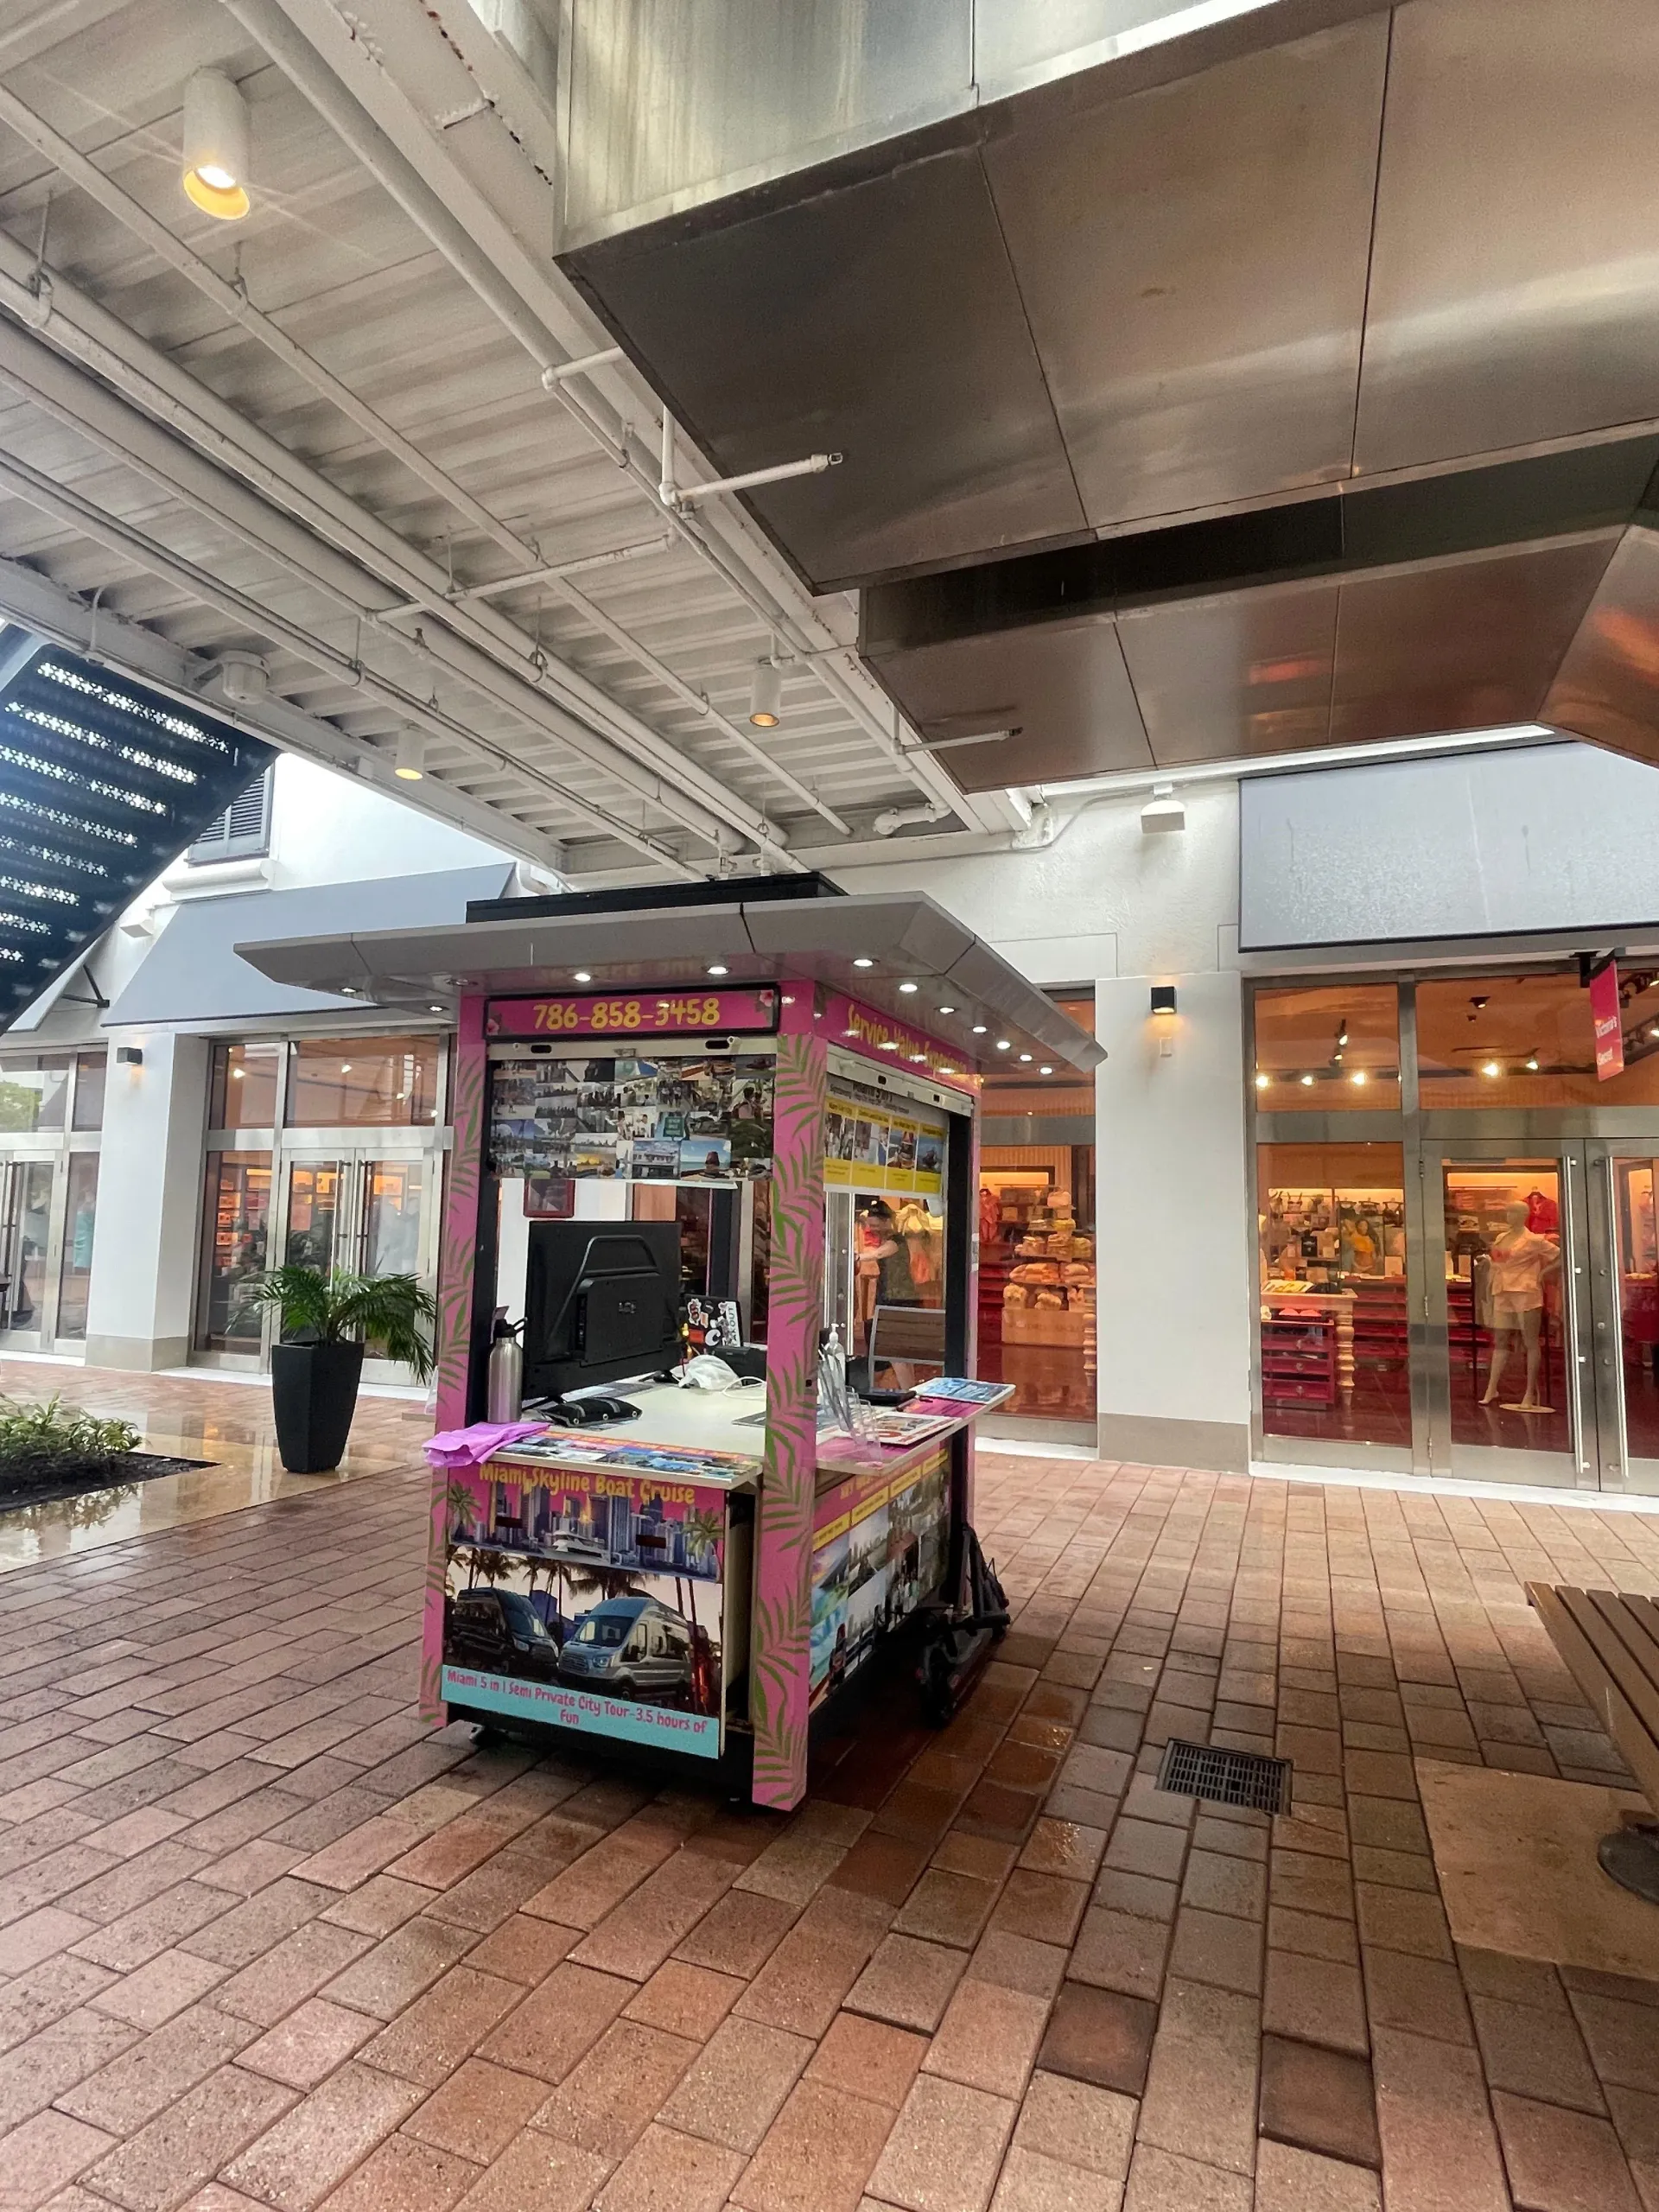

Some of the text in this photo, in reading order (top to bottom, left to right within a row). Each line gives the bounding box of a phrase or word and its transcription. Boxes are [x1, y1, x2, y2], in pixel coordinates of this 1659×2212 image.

[533, 998, 720, 1030] 786-858-3458
[480, 1464, 695, 1504] Miami Skyline Boat Cruise
[447, 1669, 477, 1686] Miami
[480, 1676, 487, 1689] 5
[490, 1679, 499, 1692] in
[508, 1681, 531, 1698] Semi
[534, 1687, 575, 1707] Private
[578, 1695, 601, 1718] City
[657, 1711, 690, 1731] hours
[693, 1720, 708, 1734] of
[560, 1708, 580, 1726] Fun
